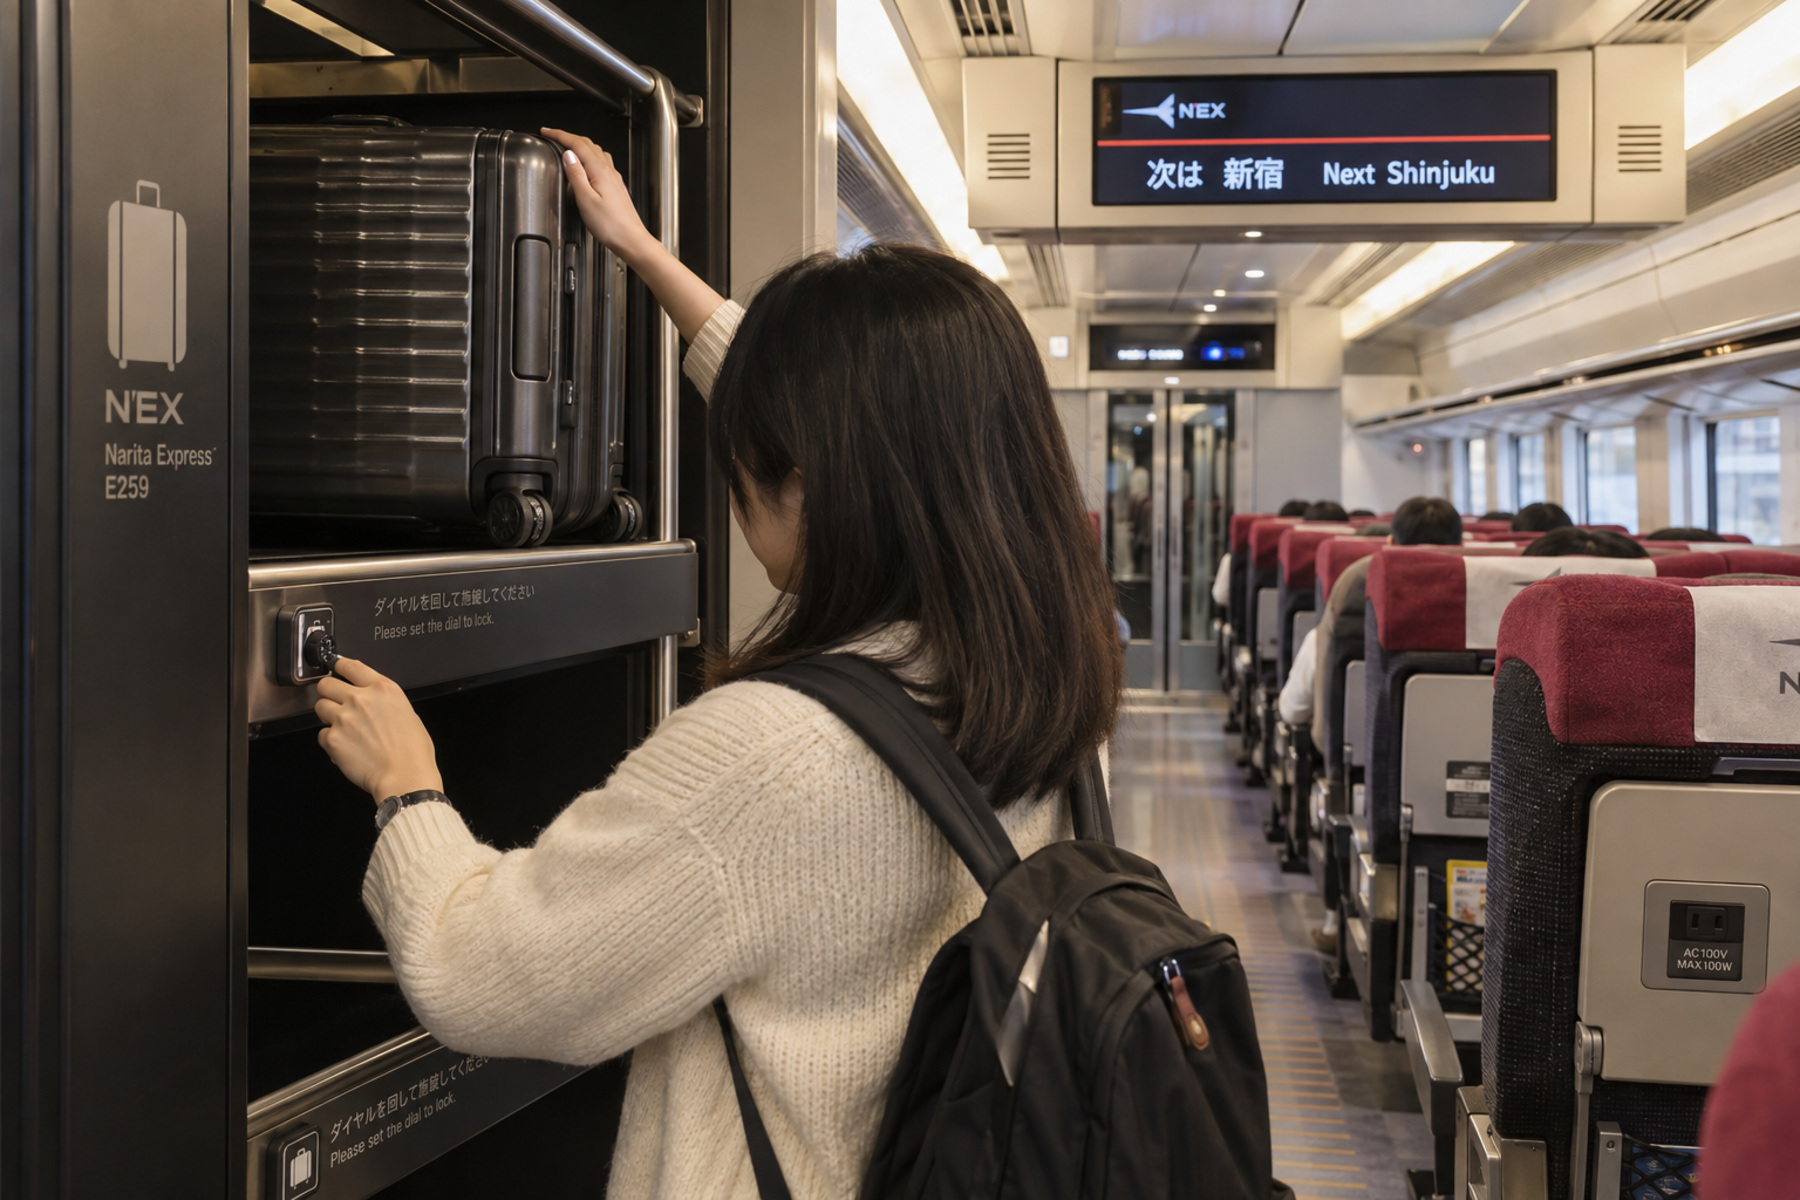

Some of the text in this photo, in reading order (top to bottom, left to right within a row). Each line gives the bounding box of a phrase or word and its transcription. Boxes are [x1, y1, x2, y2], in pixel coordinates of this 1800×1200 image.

[1146, 157, 1284, 190] 次は 新宿
[1323, 159, 1495, 190] Next Shinjuku
[105, 389, 184, 425] N'EX
[105, 443, 152, 466] Narita
[105, 475, 149, 499] E259
[374, 612, 495, 641] Please set the dial to lock.
[330, 1091, 457, 1168] Please set the dial to lock.
